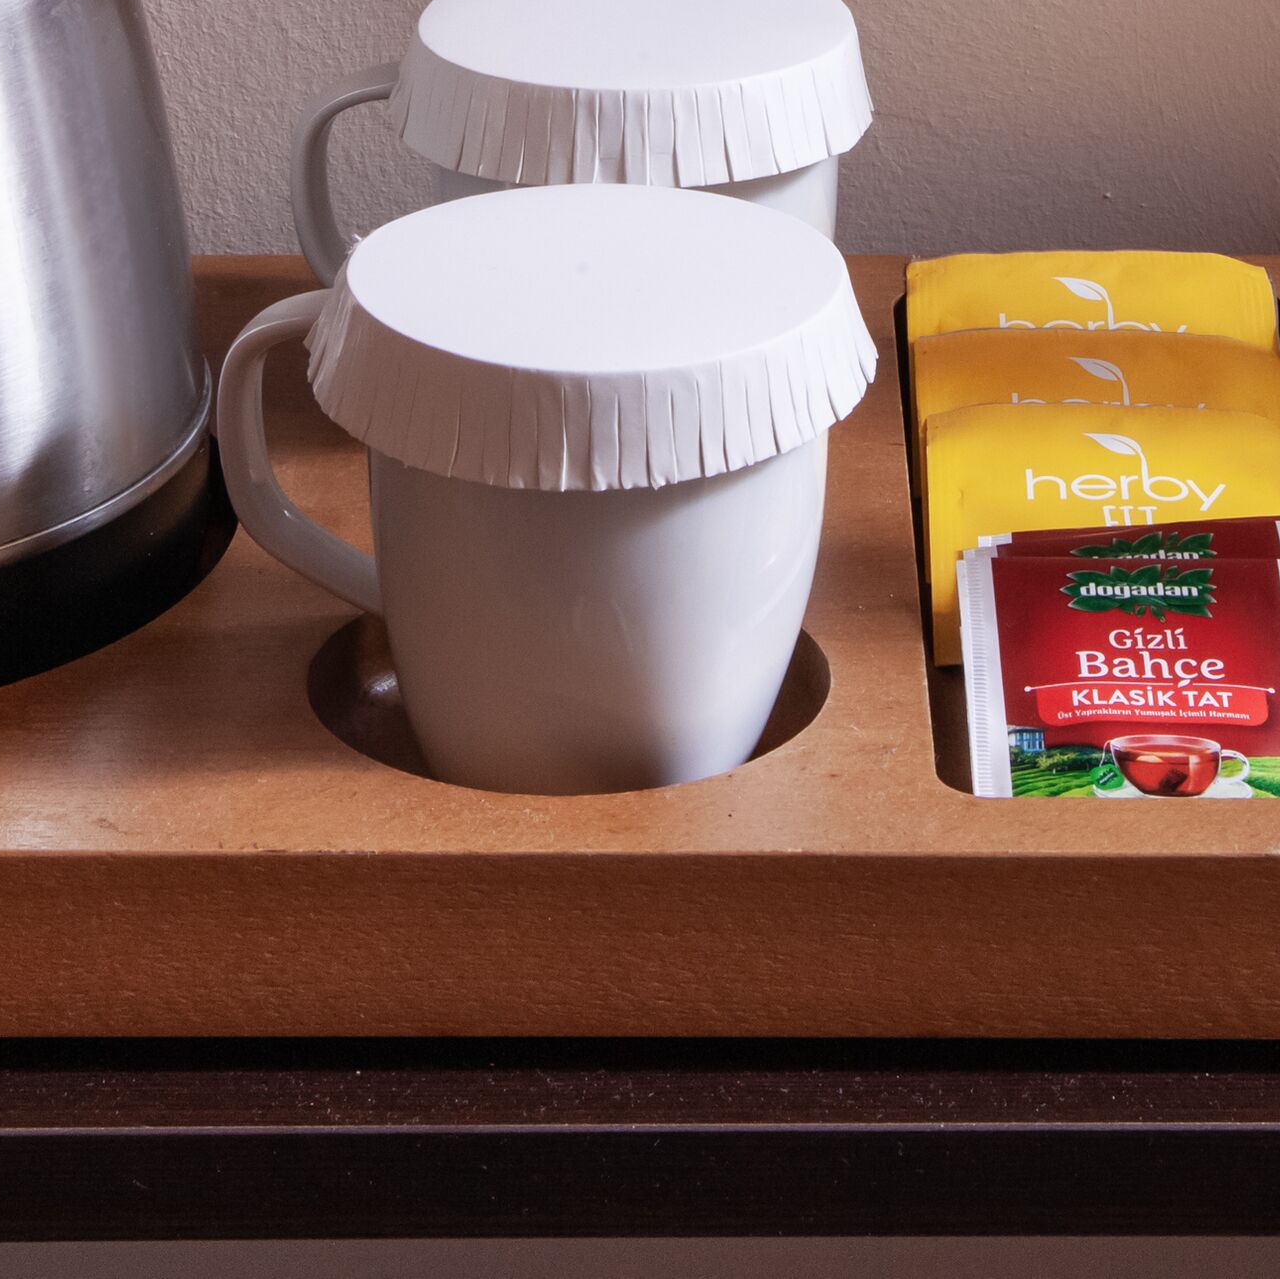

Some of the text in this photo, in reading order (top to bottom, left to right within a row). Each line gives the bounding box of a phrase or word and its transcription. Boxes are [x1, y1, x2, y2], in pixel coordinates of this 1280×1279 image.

[1025, 458, 1226, 512] herby
[1109, 627, 1186, 650] Gizli
[1075, 650, 1226, 688] Bahçe
[1072, 686, 1233, 708] KLASİK TAT
